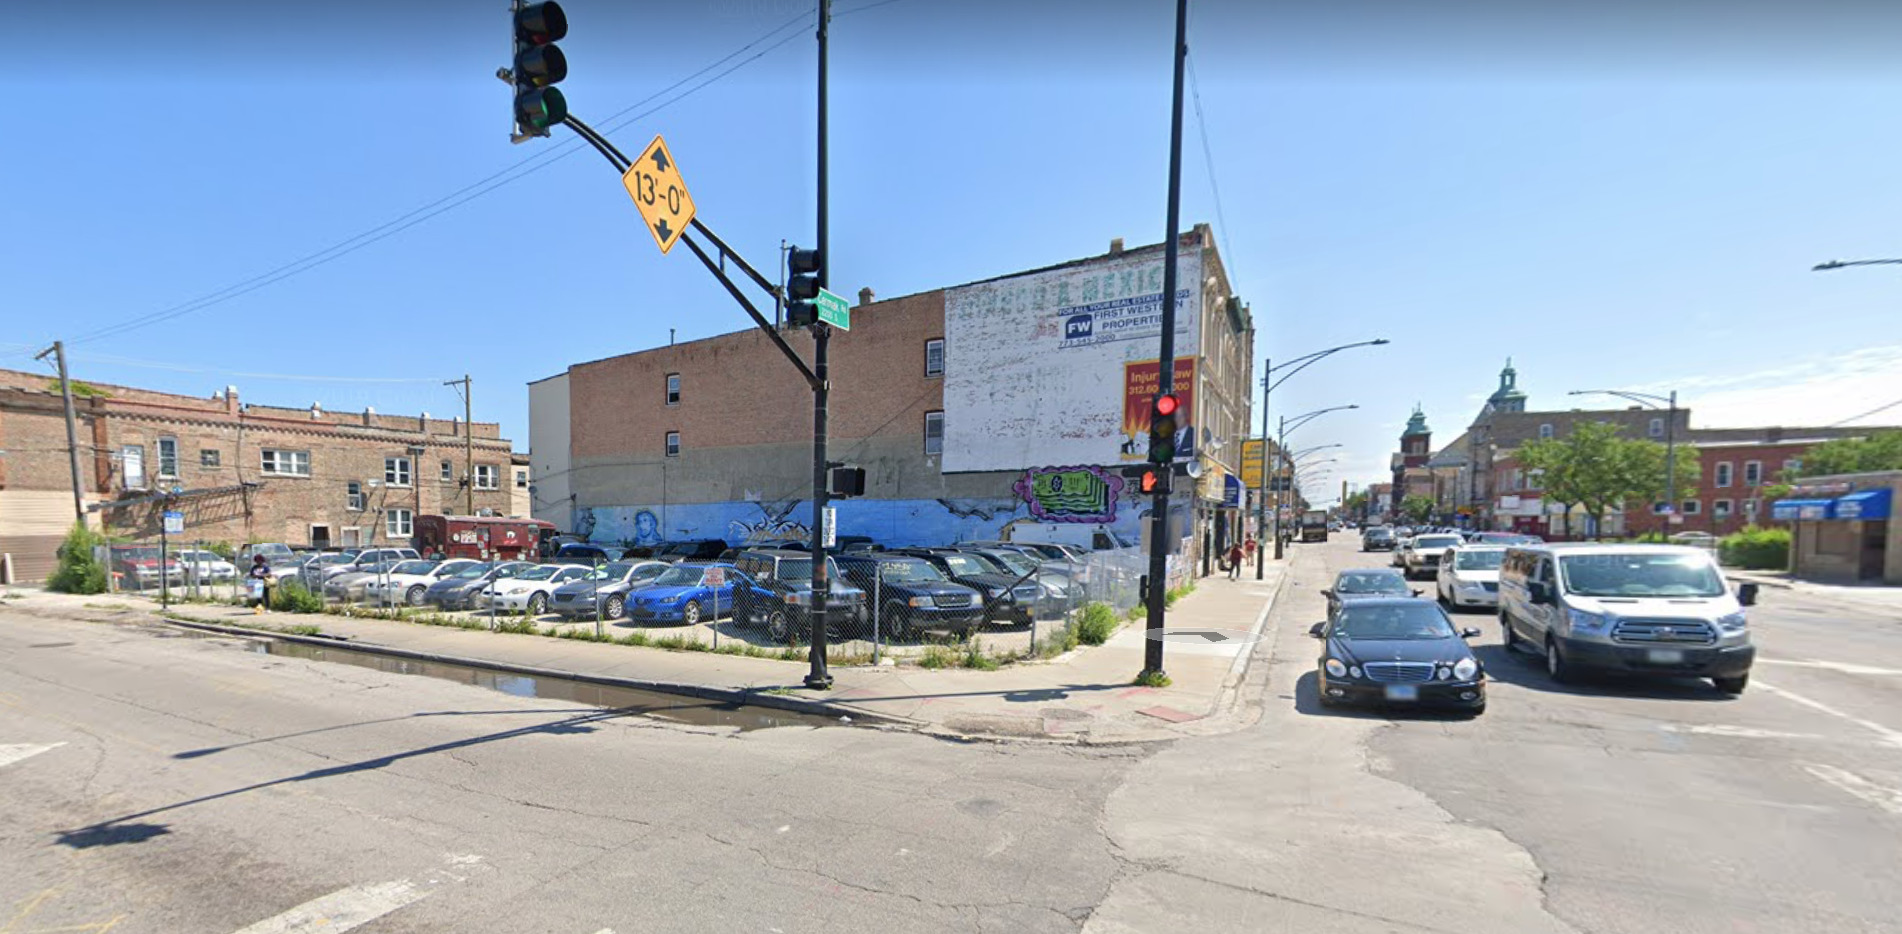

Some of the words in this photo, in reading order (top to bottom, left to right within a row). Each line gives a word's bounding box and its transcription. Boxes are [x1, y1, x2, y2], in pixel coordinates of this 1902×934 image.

[635, 170, 685, 216] 13'-0"
[1082, 267, 1181, 302] MEXIC
[1094, 308, 1124, 320] FIRST
[1127, 300, 1183, 315] WESTEN
[1068, 321, 1091, 334] FW
[1102, 314, 1163, 330] PROPERTIE
[1131, 371, 1160, 384] Injur
